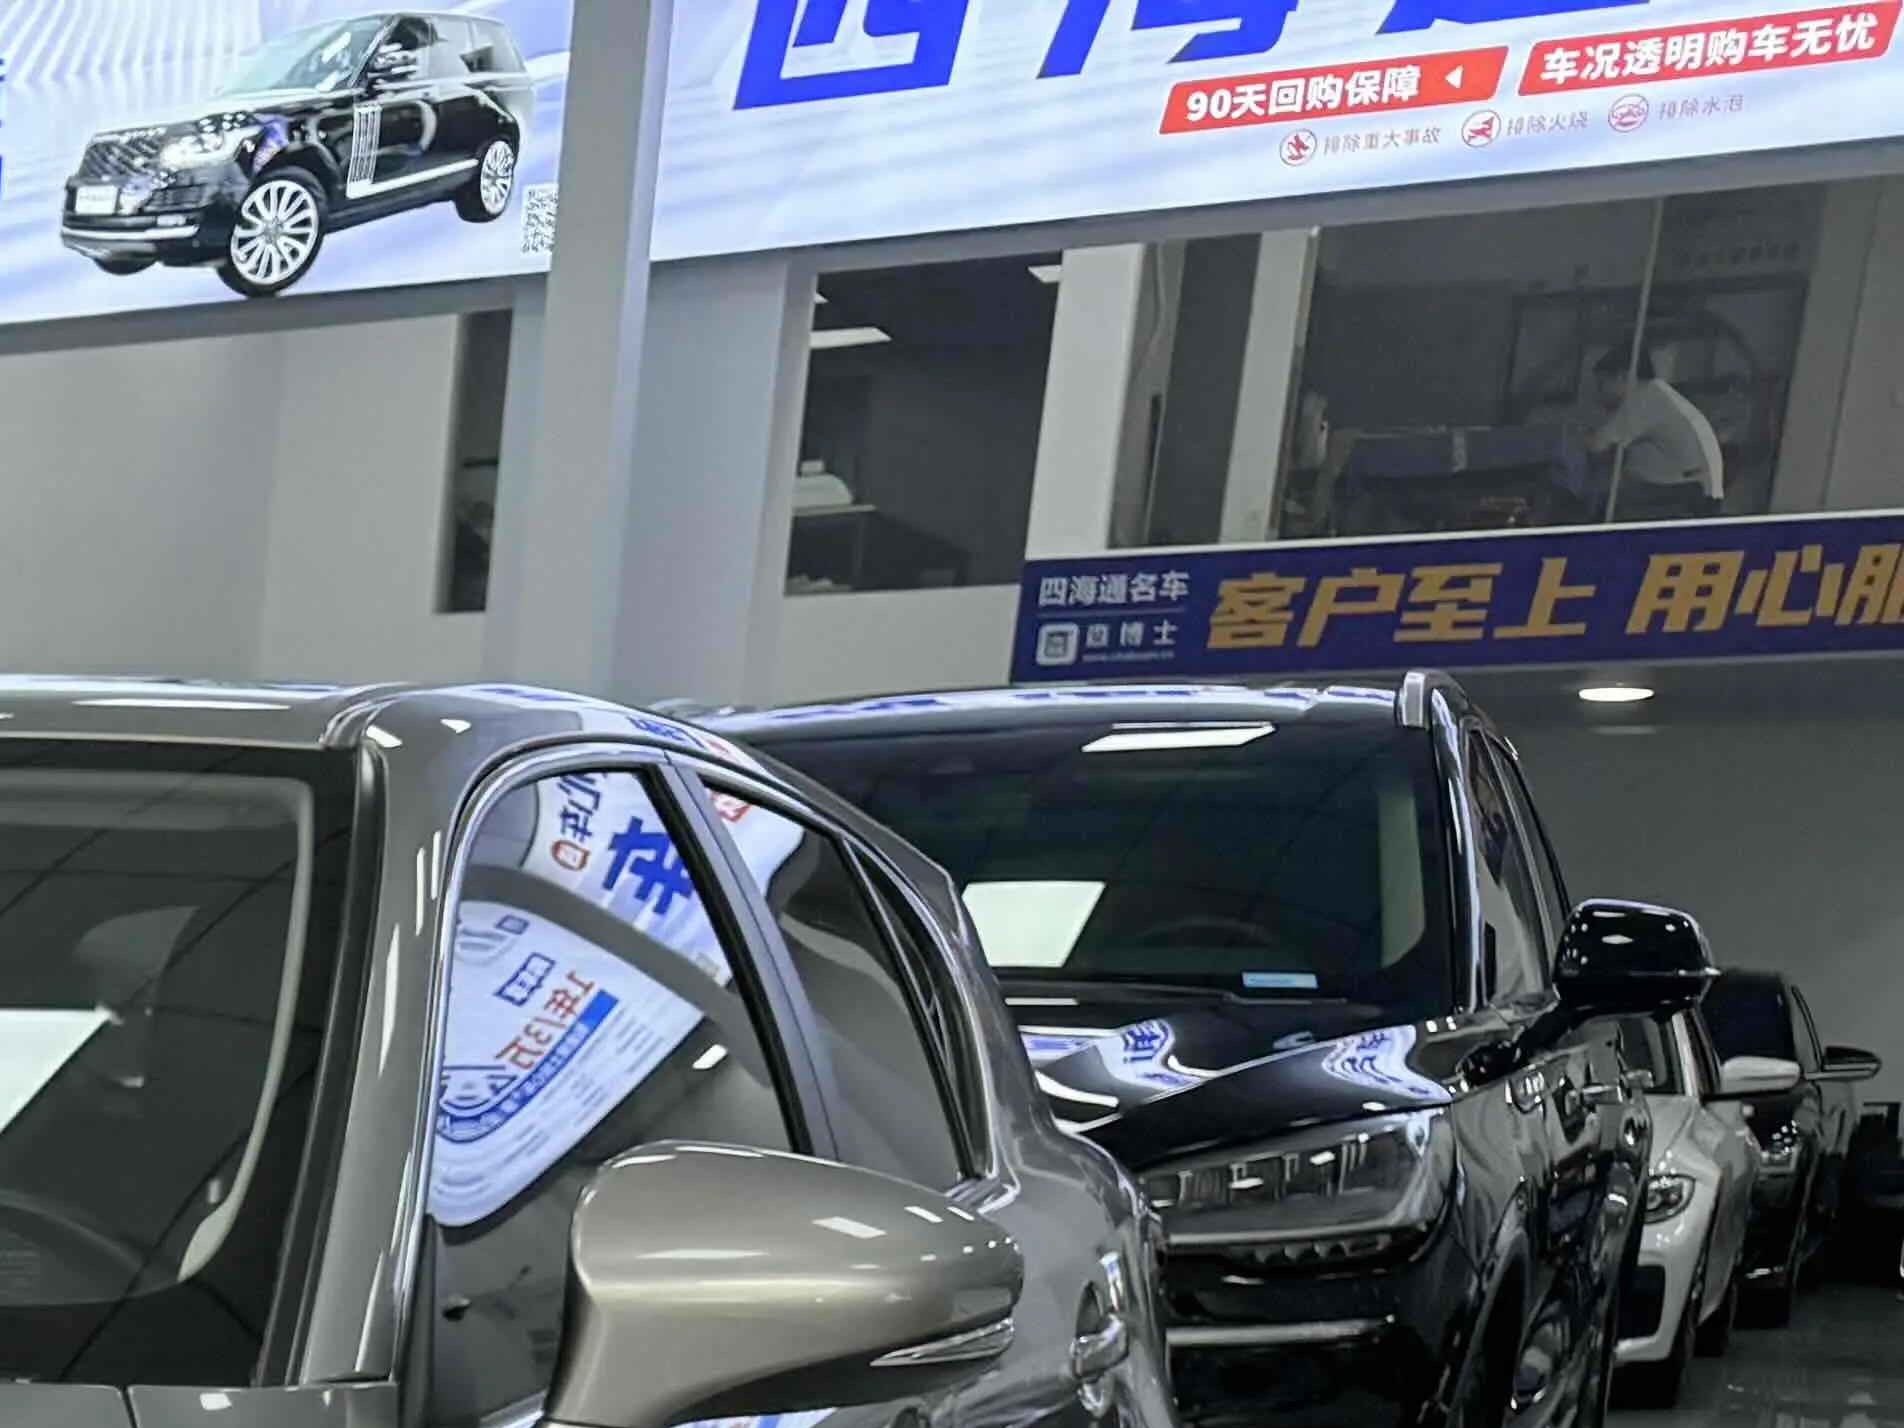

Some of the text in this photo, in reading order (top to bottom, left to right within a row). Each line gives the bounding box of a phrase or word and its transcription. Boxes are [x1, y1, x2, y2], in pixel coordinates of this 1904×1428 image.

[1540, 12, 1879, 85] 车况透明购车无忧
[1186, 65, 1421, 121] 90天回购保障
[1038, 569, 1190, 607] 四海通名车
[1205, 556, 1596, 650] 客户至上
